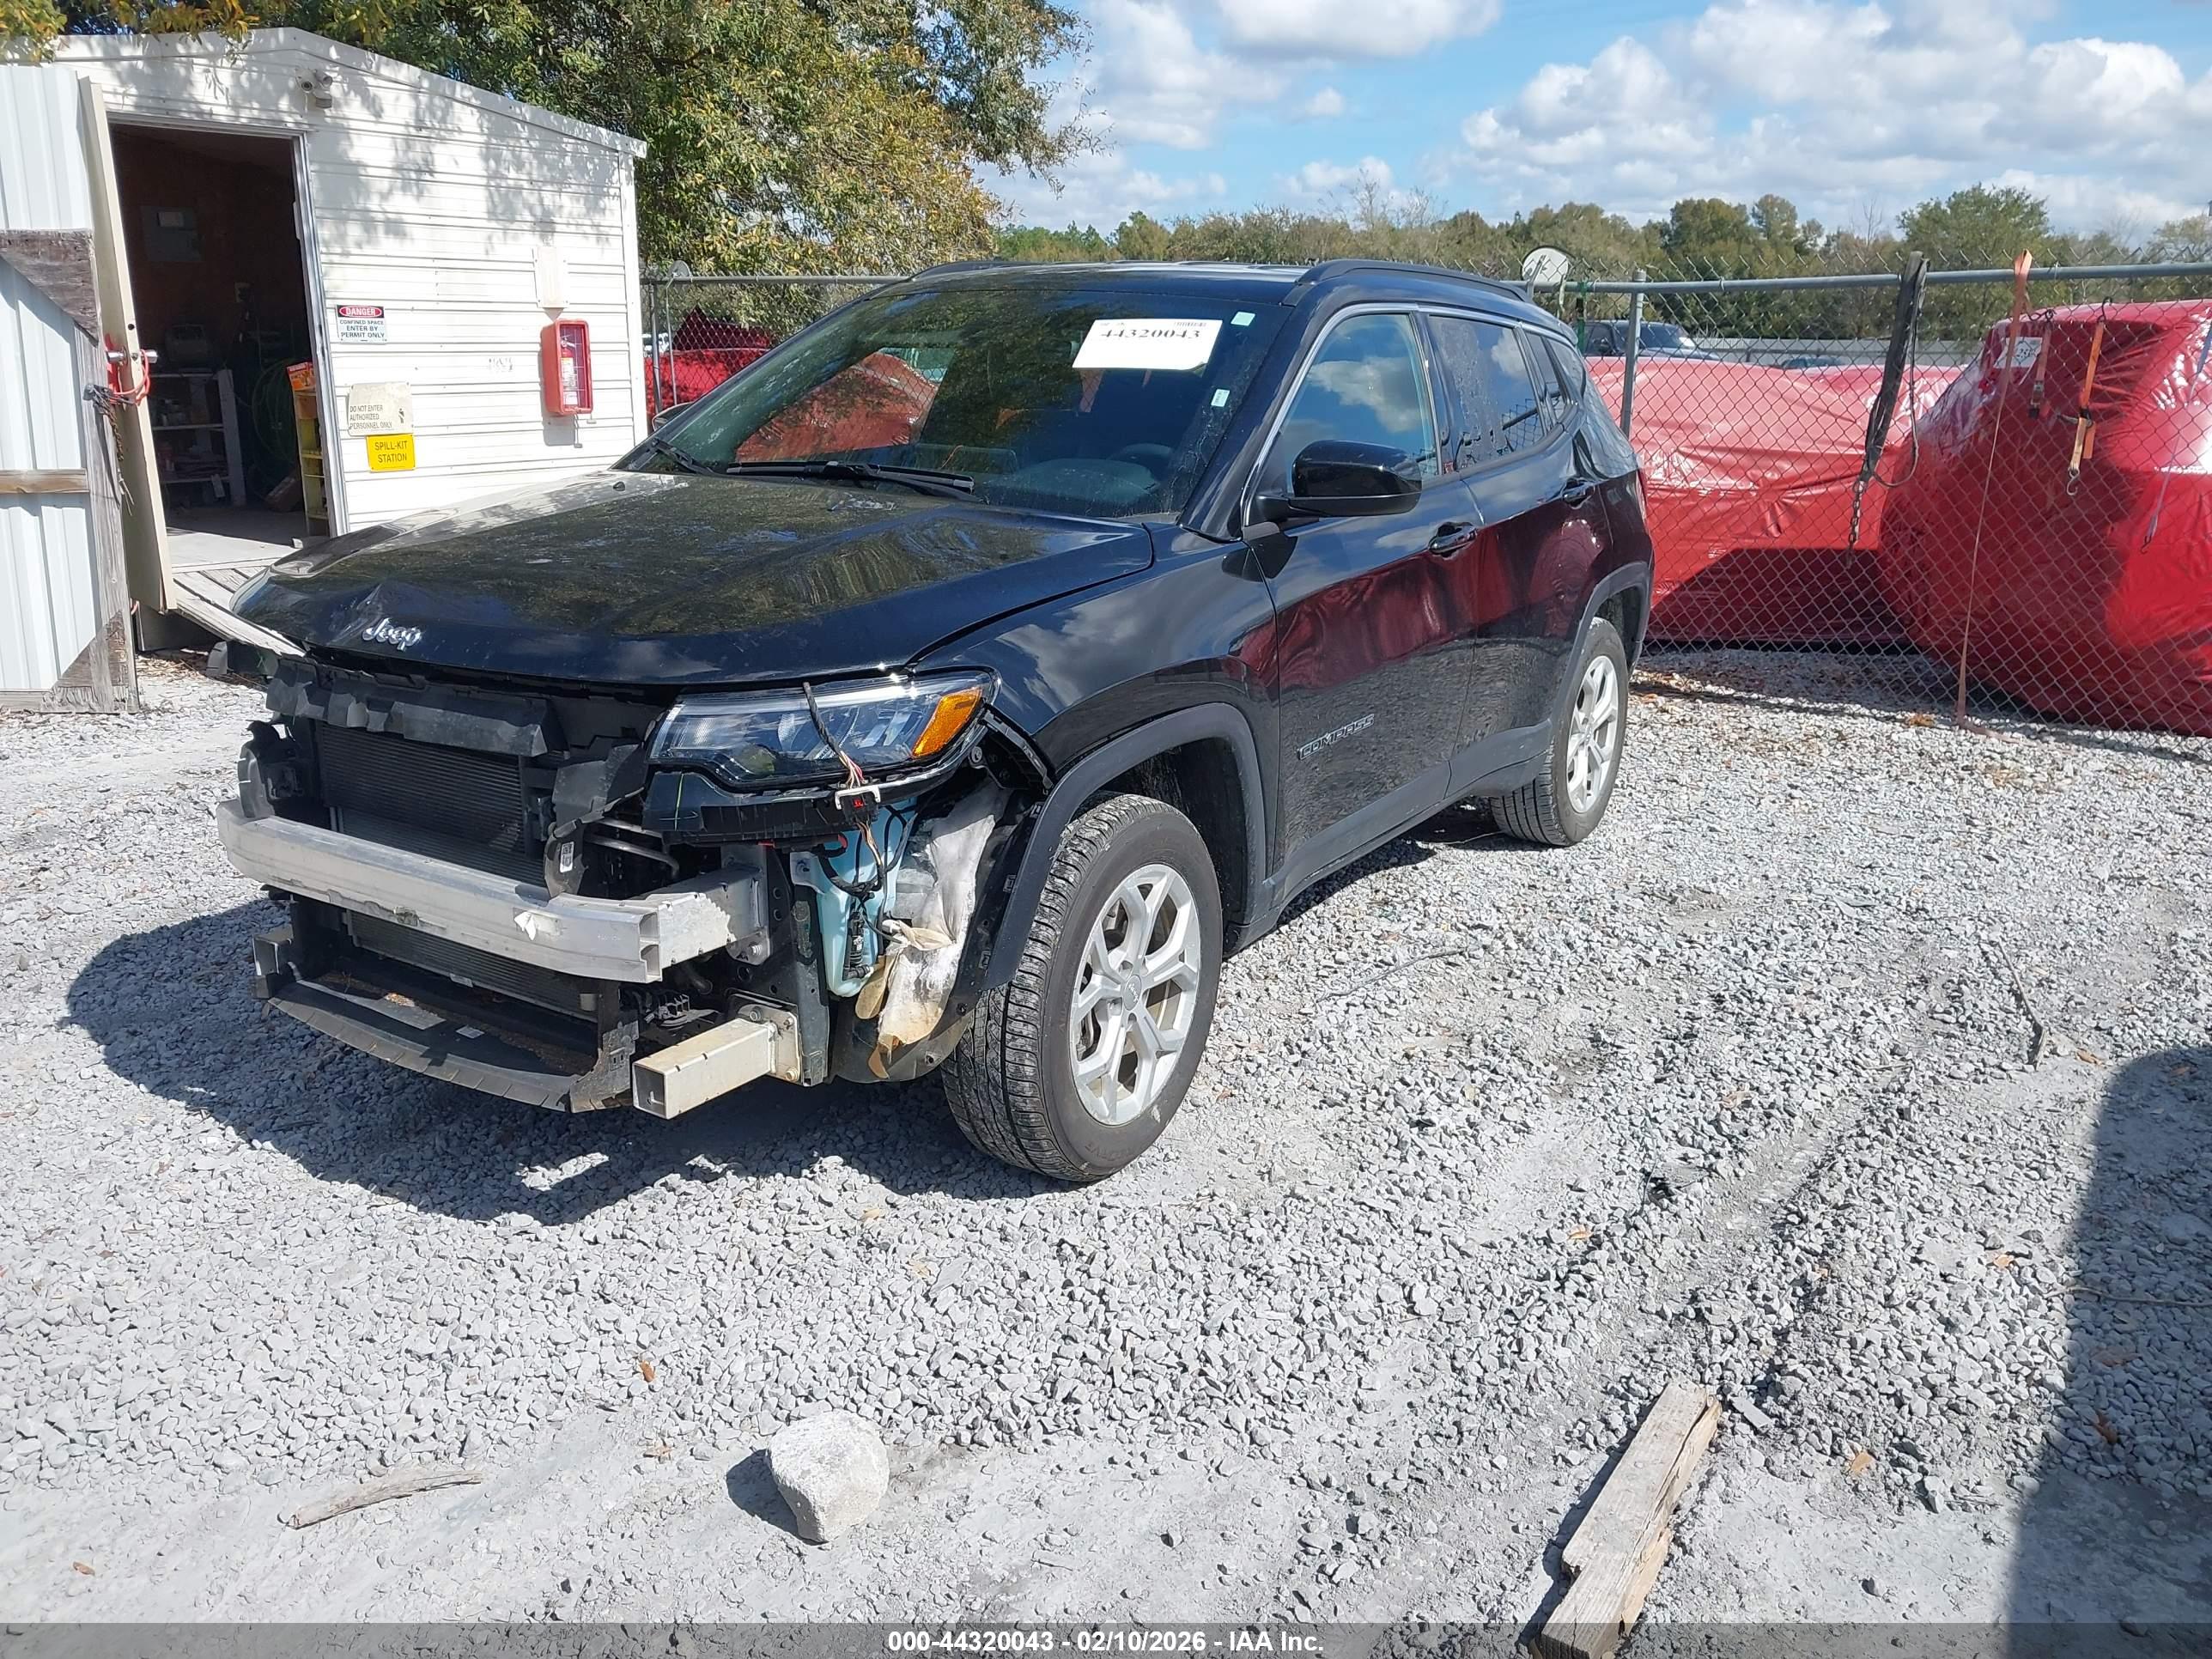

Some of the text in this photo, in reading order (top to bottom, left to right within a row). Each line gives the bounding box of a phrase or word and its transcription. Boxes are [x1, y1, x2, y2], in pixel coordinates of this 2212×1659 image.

[346, 307, 376, 316] DANGER
[1101, 329, 1200, 338] 44320043
[374, 441, 408, 451] SPILL-KIT
[378, 453, 408, 463] STATION
[362, 617, 422, 651] Jeep
[1297, 713, 1375, 761] COMPASS
